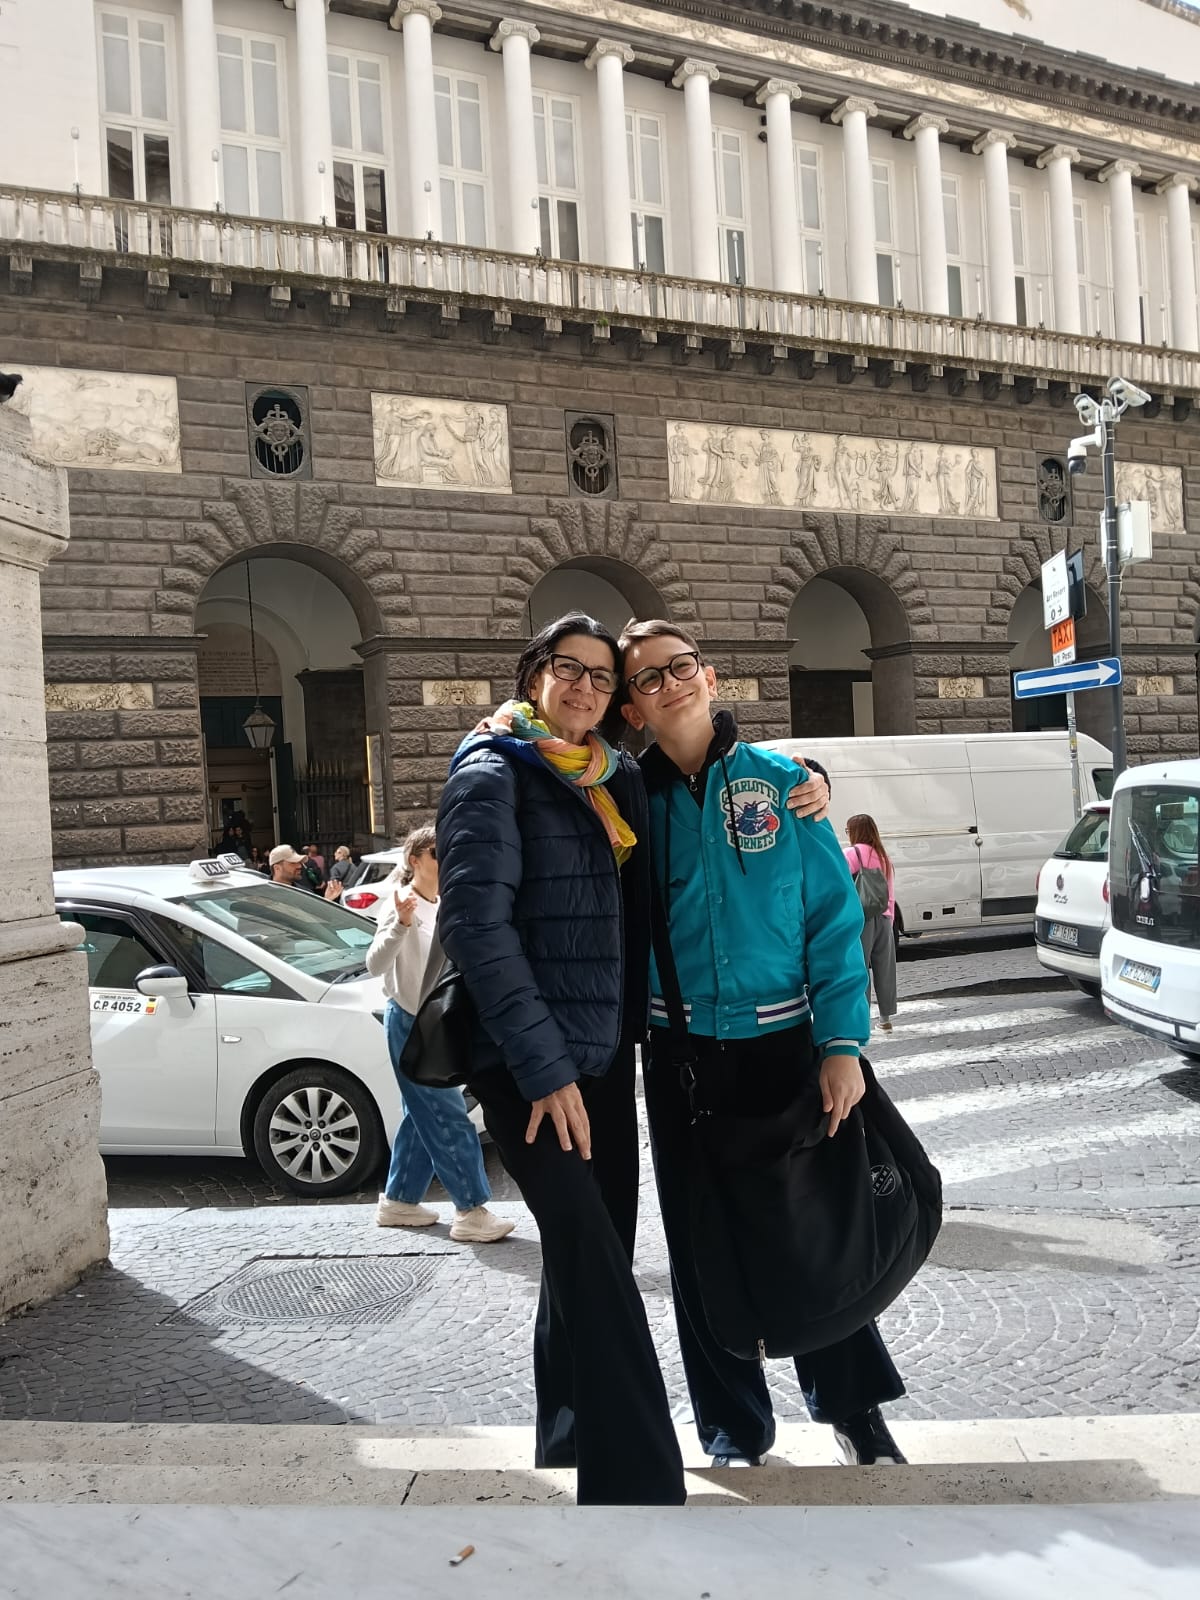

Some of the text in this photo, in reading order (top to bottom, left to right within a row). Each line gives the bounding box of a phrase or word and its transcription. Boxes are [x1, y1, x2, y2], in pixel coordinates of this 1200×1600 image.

[1052, 620, 1073, 649] TAXI
[200, 862, 228, 875] TAXI
[111, 1001, 141, 1012] 4052
